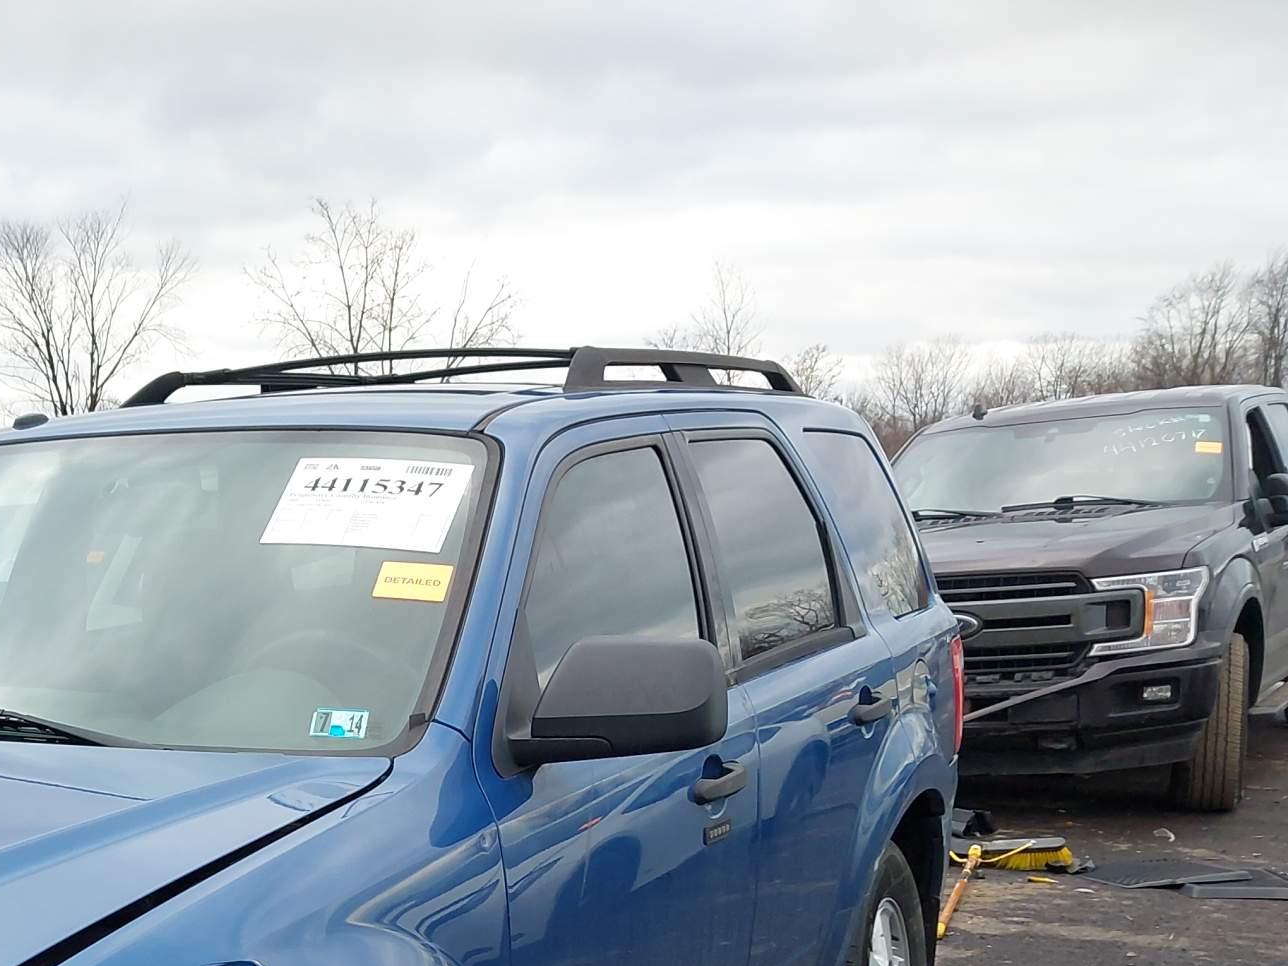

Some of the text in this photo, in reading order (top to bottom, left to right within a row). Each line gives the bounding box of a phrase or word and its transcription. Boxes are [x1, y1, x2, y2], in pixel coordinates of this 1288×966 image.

[303, 476, 445, 498] 44115347
[384, 576, 441, 587] DETAILED
[346, 713, 364, 736] 14
